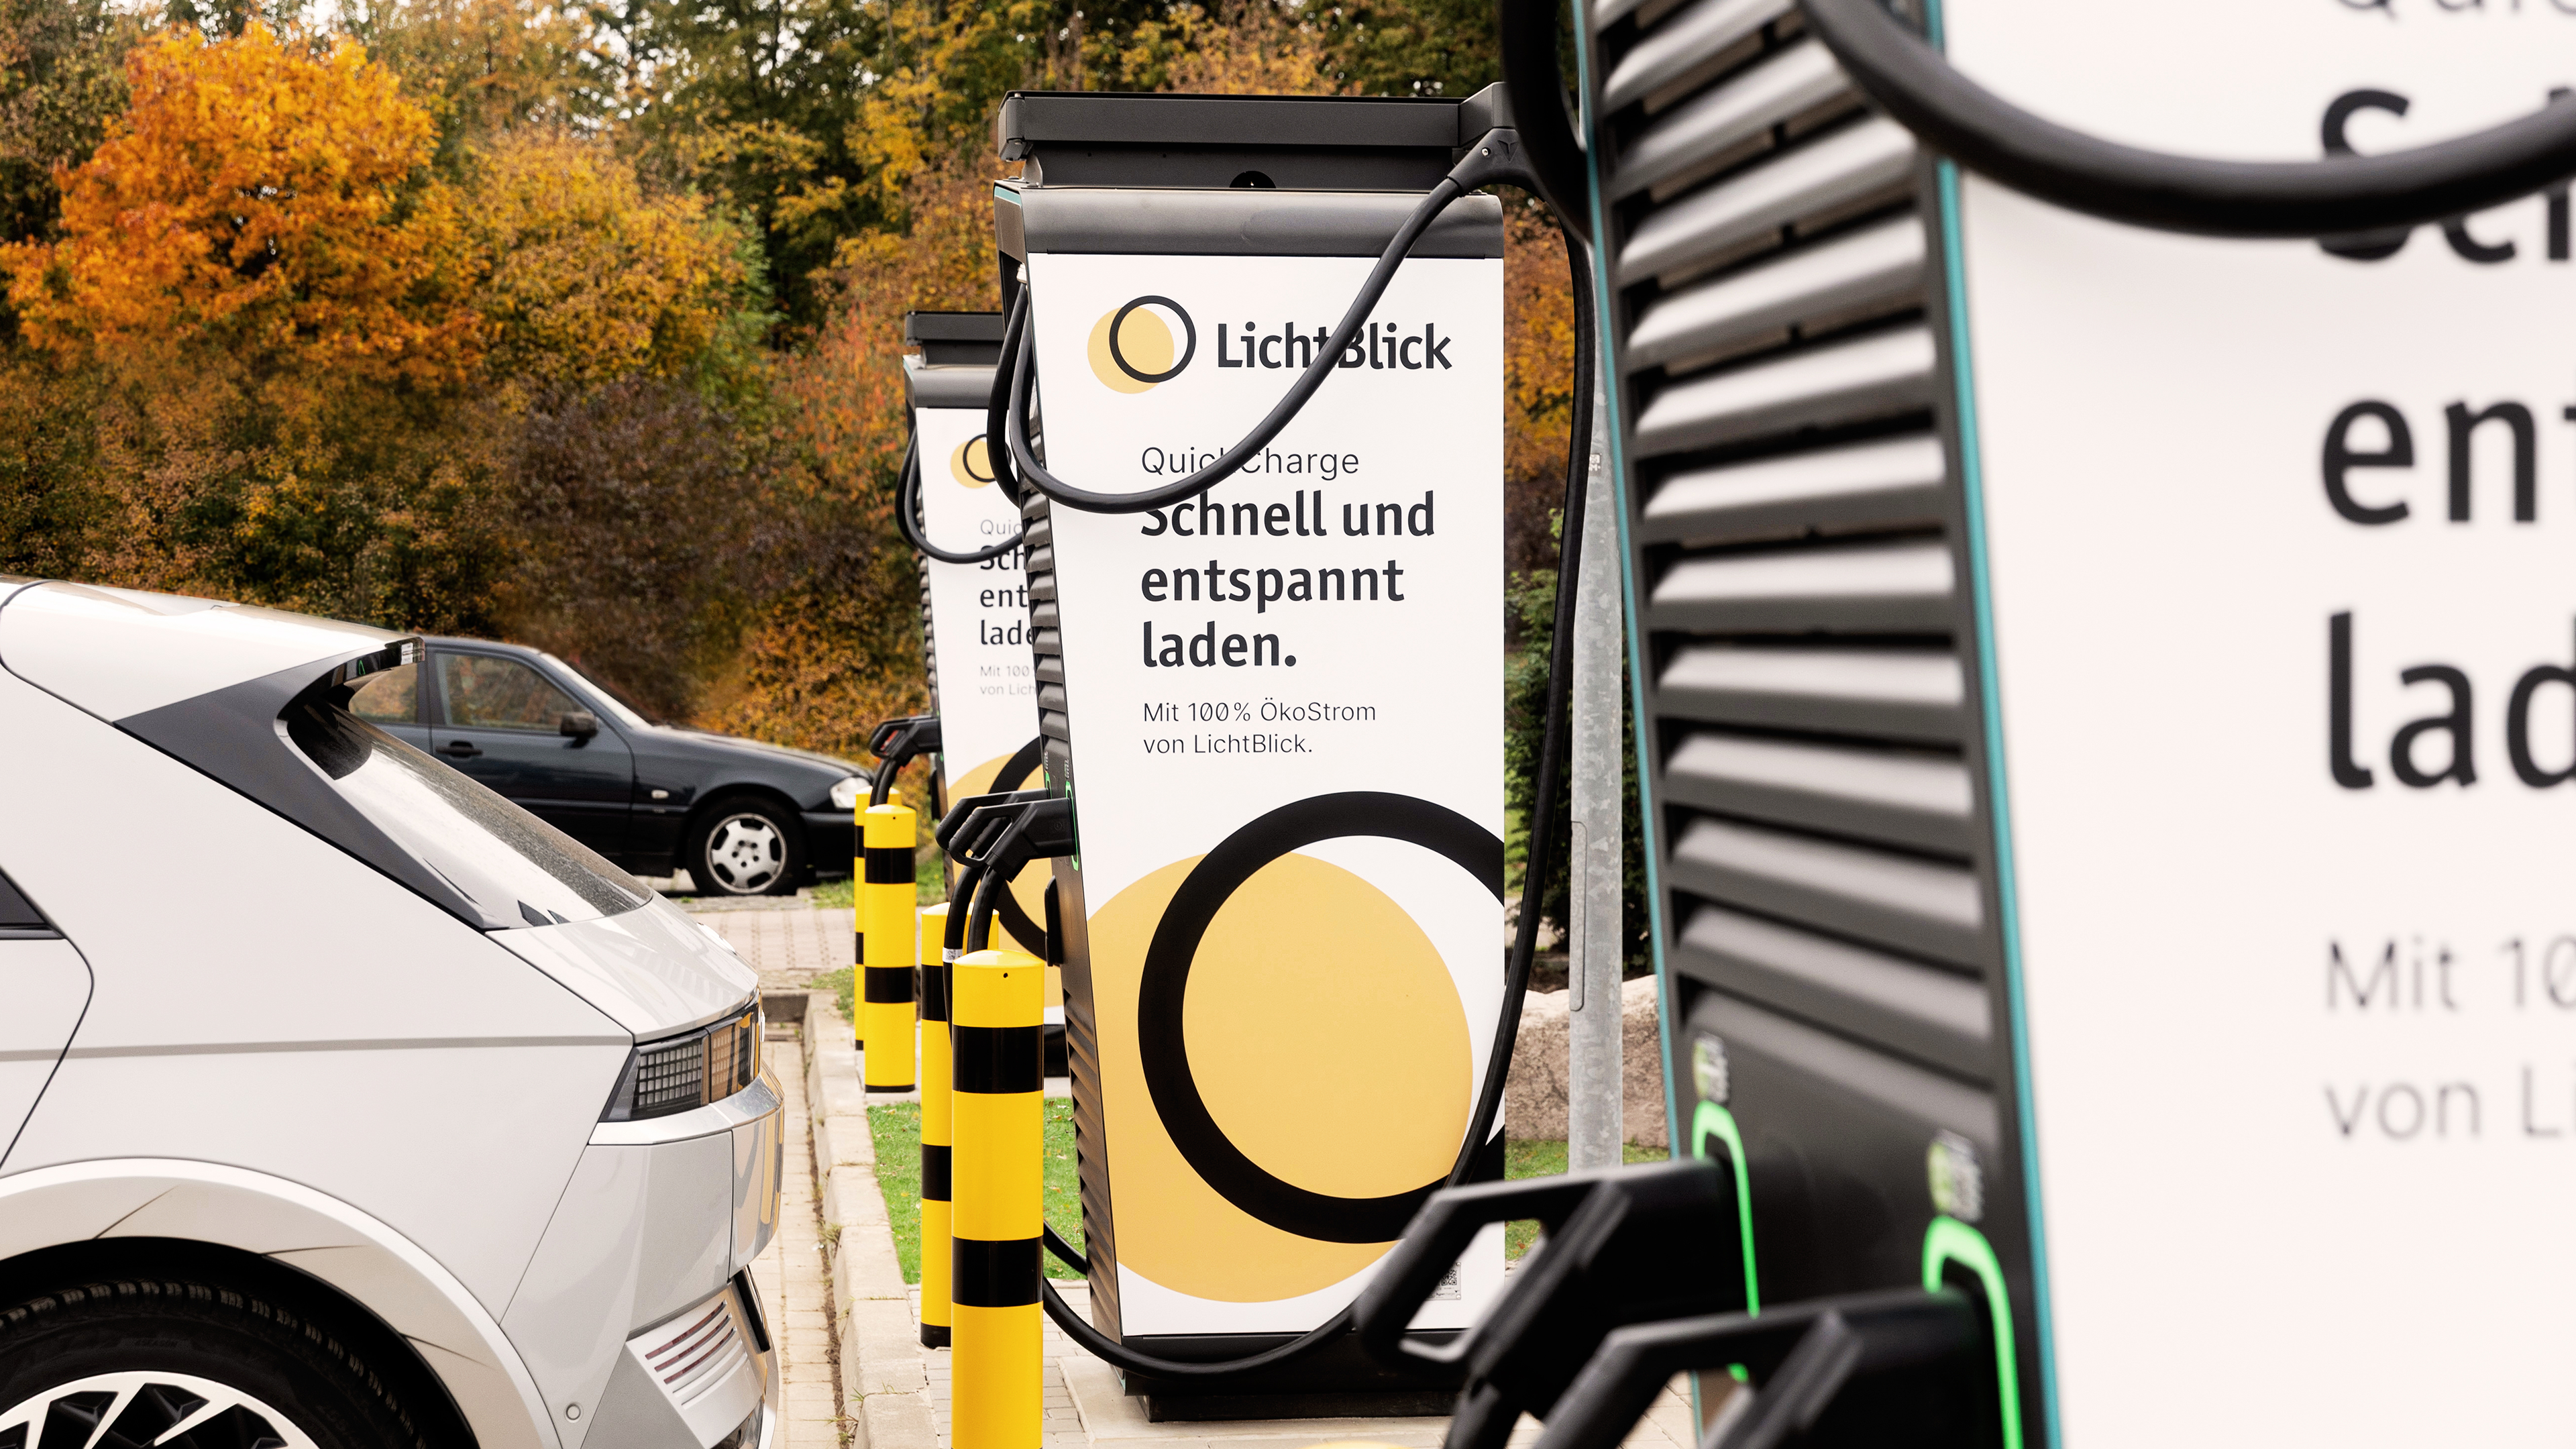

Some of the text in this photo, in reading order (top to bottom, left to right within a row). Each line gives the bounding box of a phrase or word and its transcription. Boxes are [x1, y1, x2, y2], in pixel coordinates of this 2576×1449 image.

[2322, 400, 2576, 527] en
[1141, 490, 1435, 537] Schnell und
[1141, 559, 1405, 614] entspannt
[1143, 621, 1297, 667] laden.
[979, 686, 1004, 696] von
[980, 665, 1000, 677] Mit
[1144, 702, 1179, 722] Mit
[1260, 697, 1376, 722] ÖkoStrom
[1143, 733, 1313, 754] von LichtBlick.
[2326, 936, 2458, 1012] Mit
[2323, 1079, 2482, 1141] von
